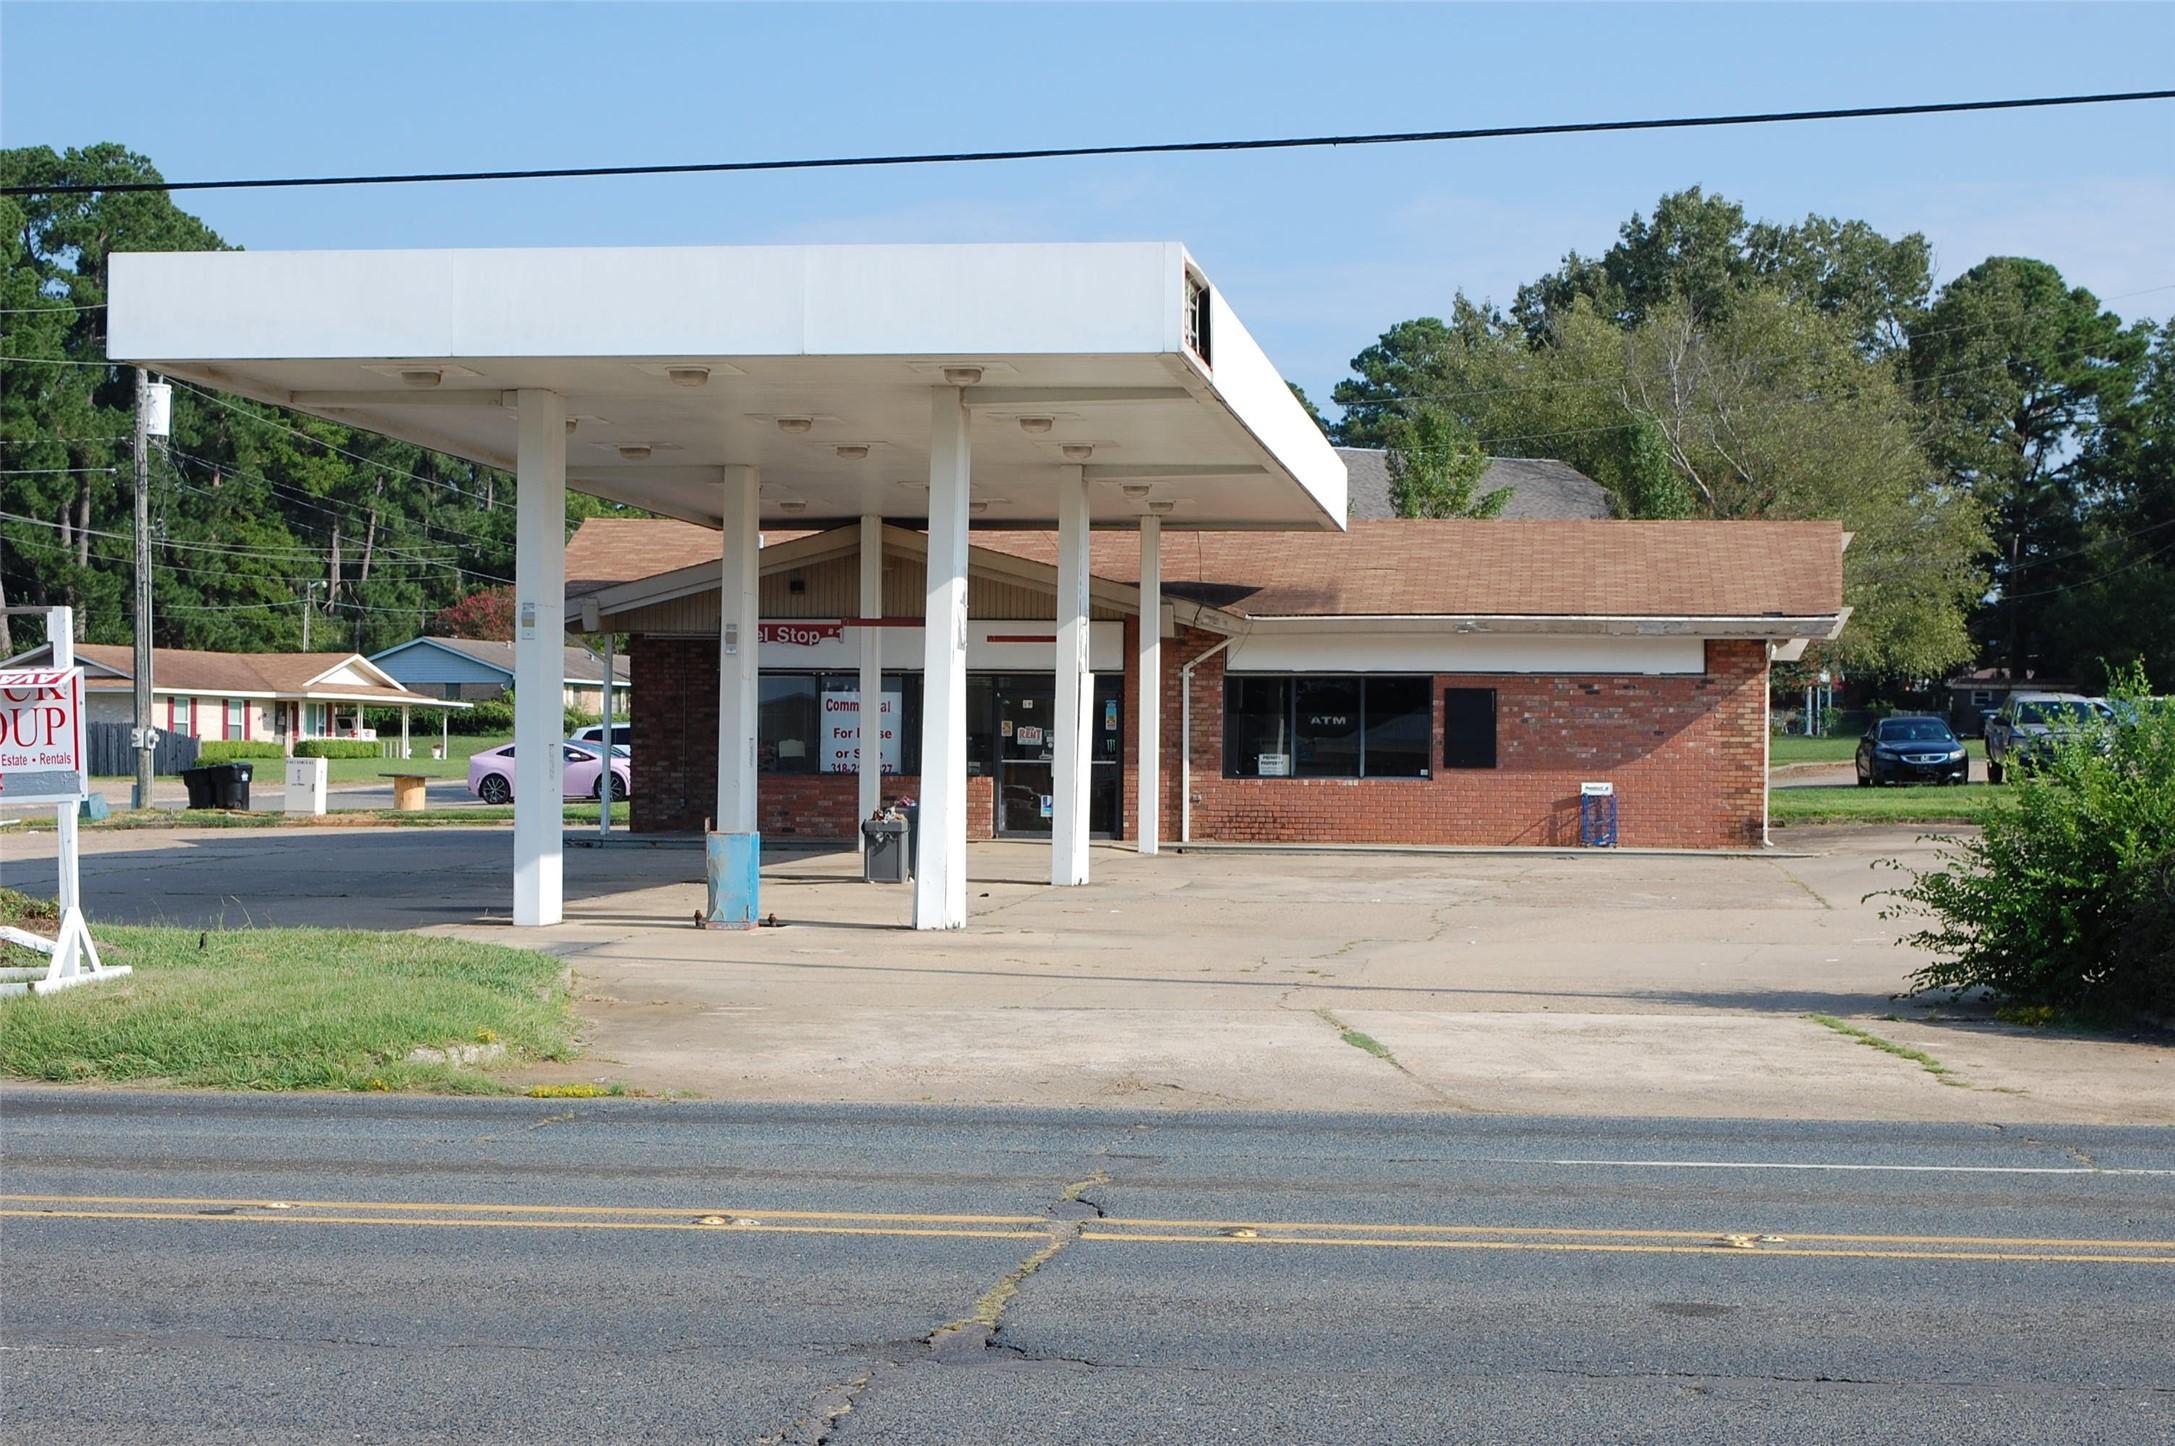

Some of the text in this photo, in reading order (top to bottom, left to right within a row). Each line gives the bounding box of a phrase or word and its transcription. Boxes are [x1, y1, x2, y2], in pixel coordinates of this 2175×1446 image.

[777, 627, 820, 646] Stop
[826, 698, 891, 712] Commal
[0, 708, 66, 747] UP
[1311, 717, 1346, 725] ATM
[833, 727, 853, 739] For
[1, 752, 72, 766] Estate Rentals
[835, 750, 849, 759] or
